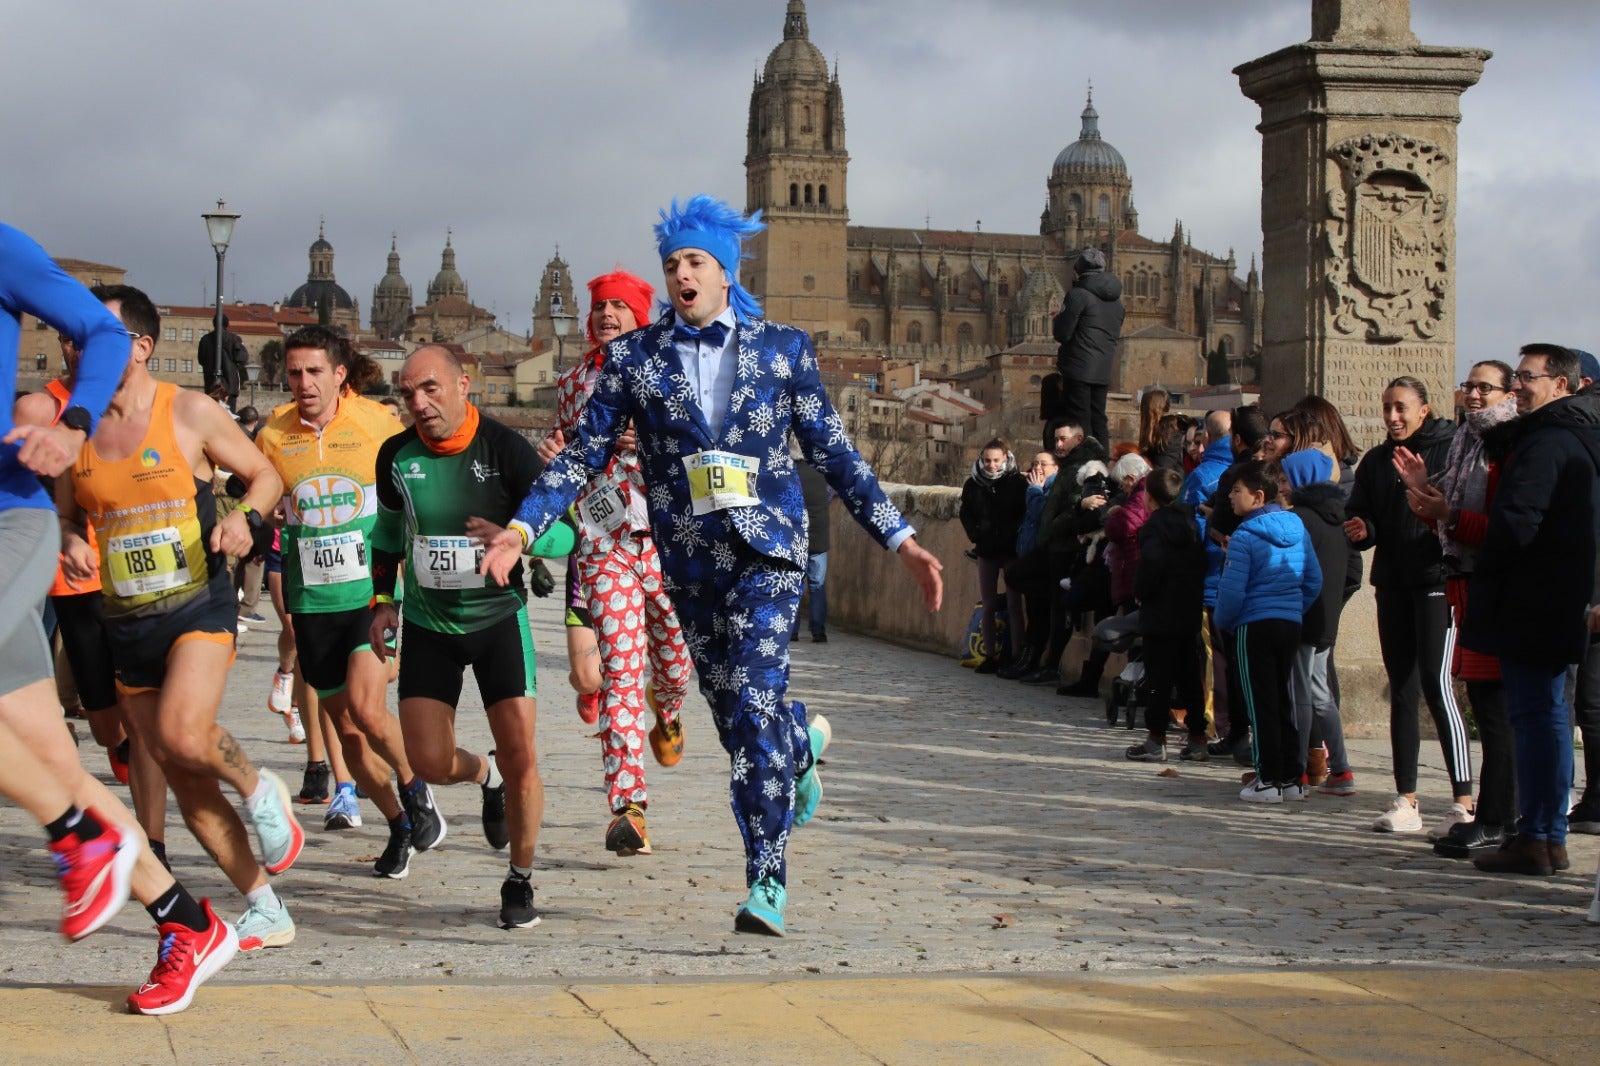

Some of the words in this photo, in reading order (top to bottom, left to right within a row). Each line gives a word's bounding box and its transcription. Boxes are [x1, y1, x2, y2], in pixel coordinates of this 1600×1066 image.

[701, 454, 750, 469] SETEL
[706, 466, 725, 489] 19
[297, 491, 358, 511] ALCER
[587, 484, 614, 505] SETEL
[589, 497, 614, 523] 650
[123, 533, 171, 549] SETEL
[313, 536, 356, 548] SETEL
[429, 539, 475, 548] SETEL
[125, 548, 156, 574] 188
[313, 547, 345, 568] 404
[429, 550, 456, 571] 251
